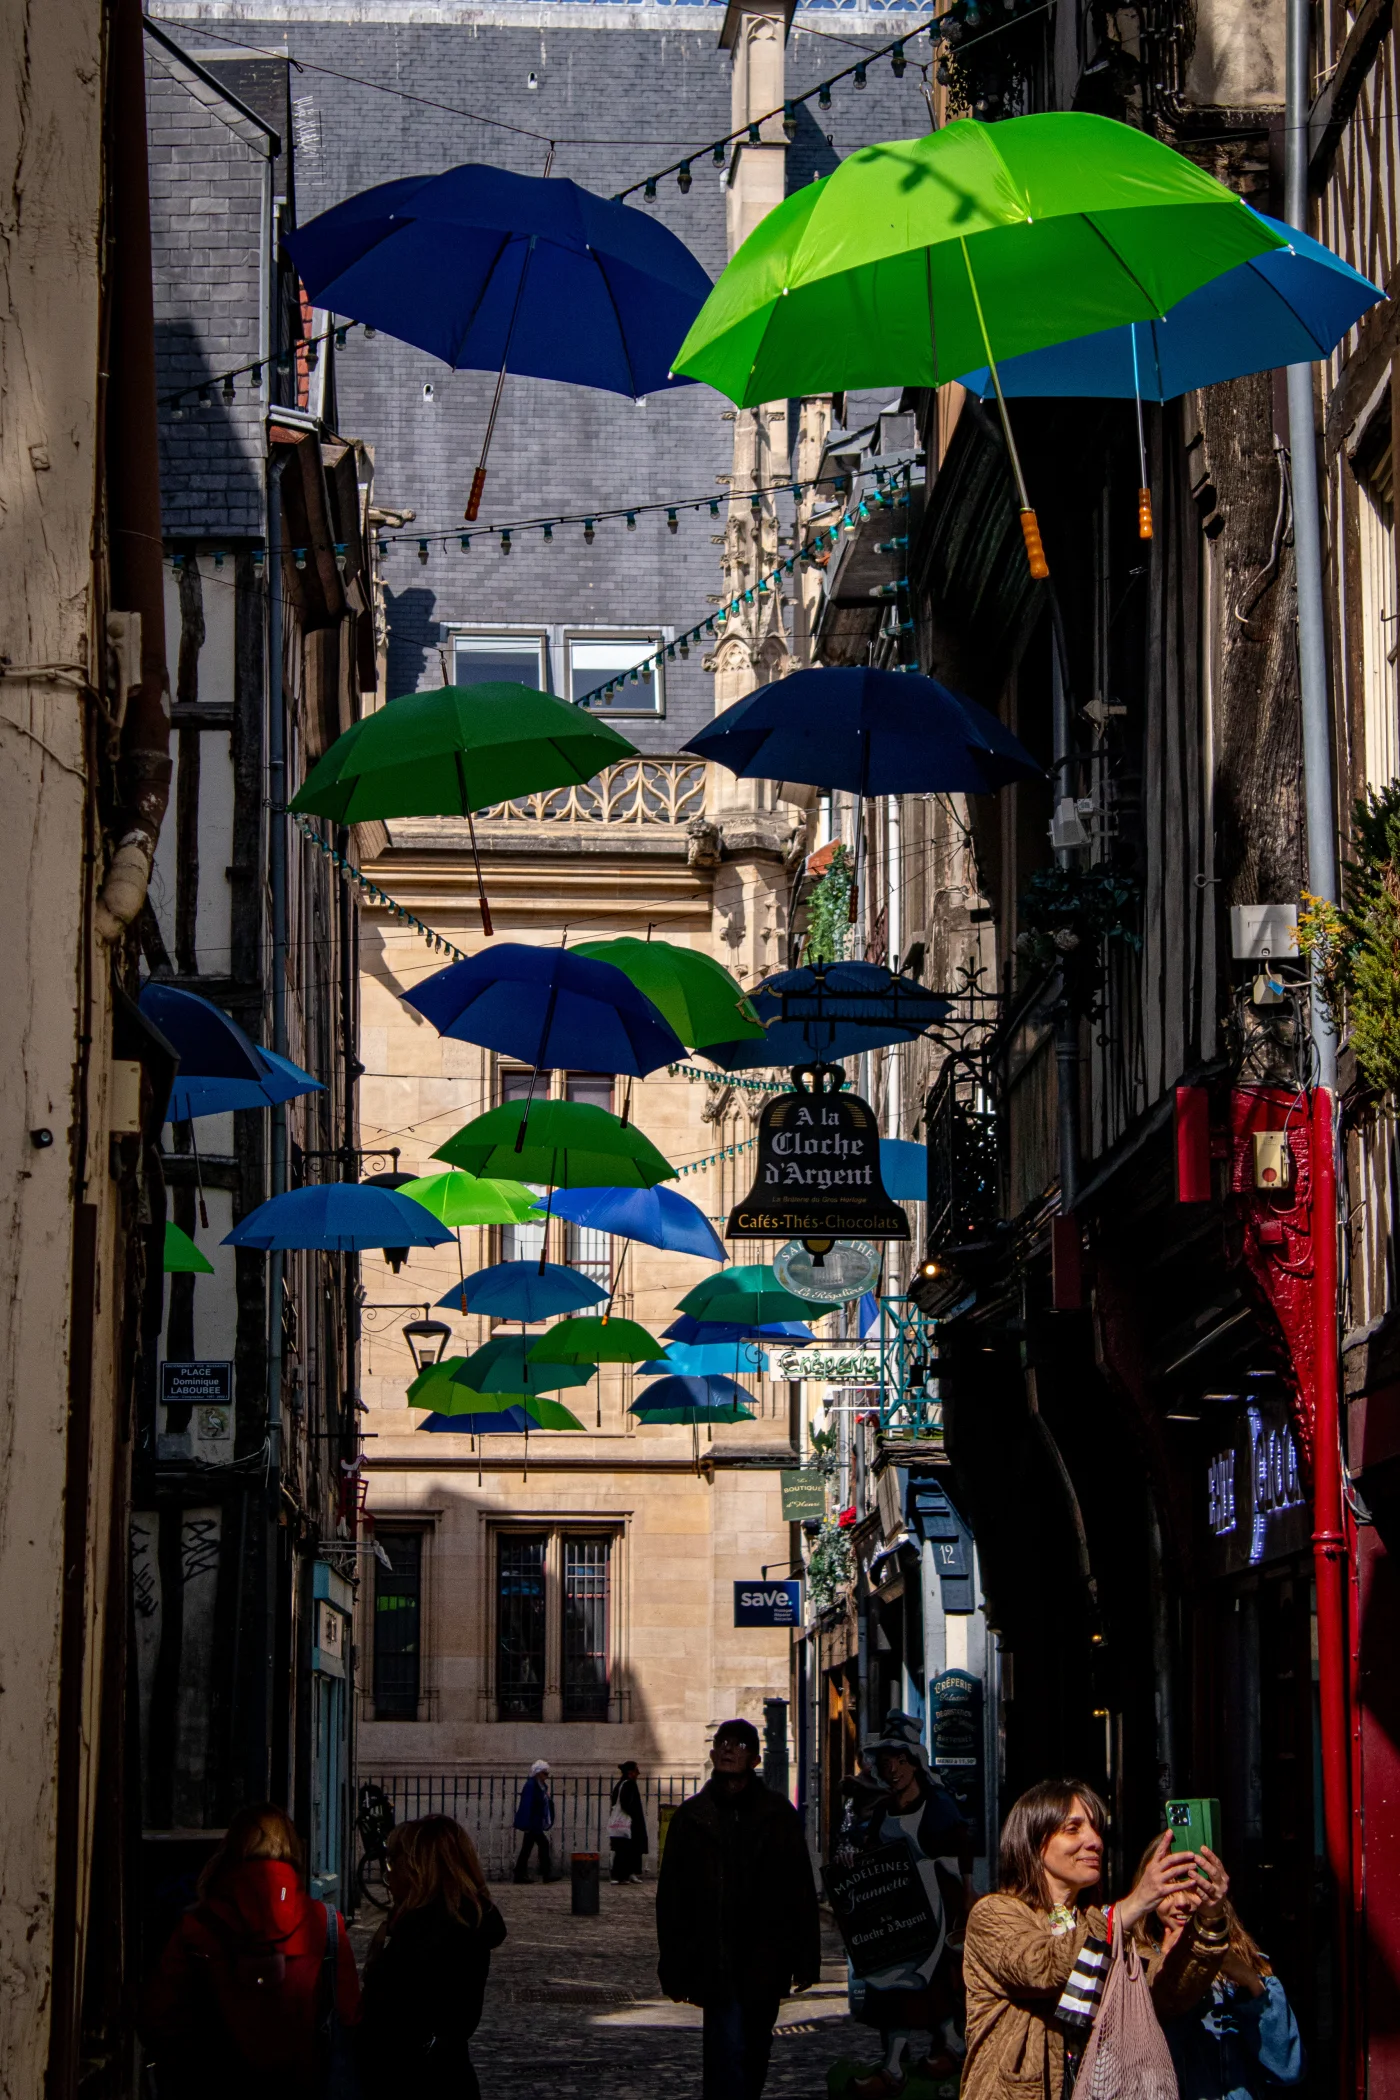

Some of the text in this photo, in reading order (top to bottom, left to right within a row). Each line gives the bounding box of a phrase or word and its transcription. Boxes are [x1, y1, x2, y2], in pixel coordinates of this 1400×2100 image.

[795, 1106, 840, 1126] A la
[771, 1131, 865, 1161] Cloche
[764, 1162, 873, 1190] d'Argent
[738, 1213, 899, 1230] Cafés-Thés-Chocolats
[794, 1285, 865, 1302] La Régalière
[181, 1368, 212, 1376] PLACE
[780, 1347, 878, 1380] Crêperie
[173, 1377, 219, 1386] Dominique
[783, 1485, 823, 1494] BOUTIQUE
[939, 1544, 955, 1564] 12
[933, 1676, 973, 1694] CRÊPERIE
[833, 1861, 911, 1896] MADELEINES
[840, 1875, 909, 1915] Jeannette
[851, 1927, 885, 1946] Cloche
